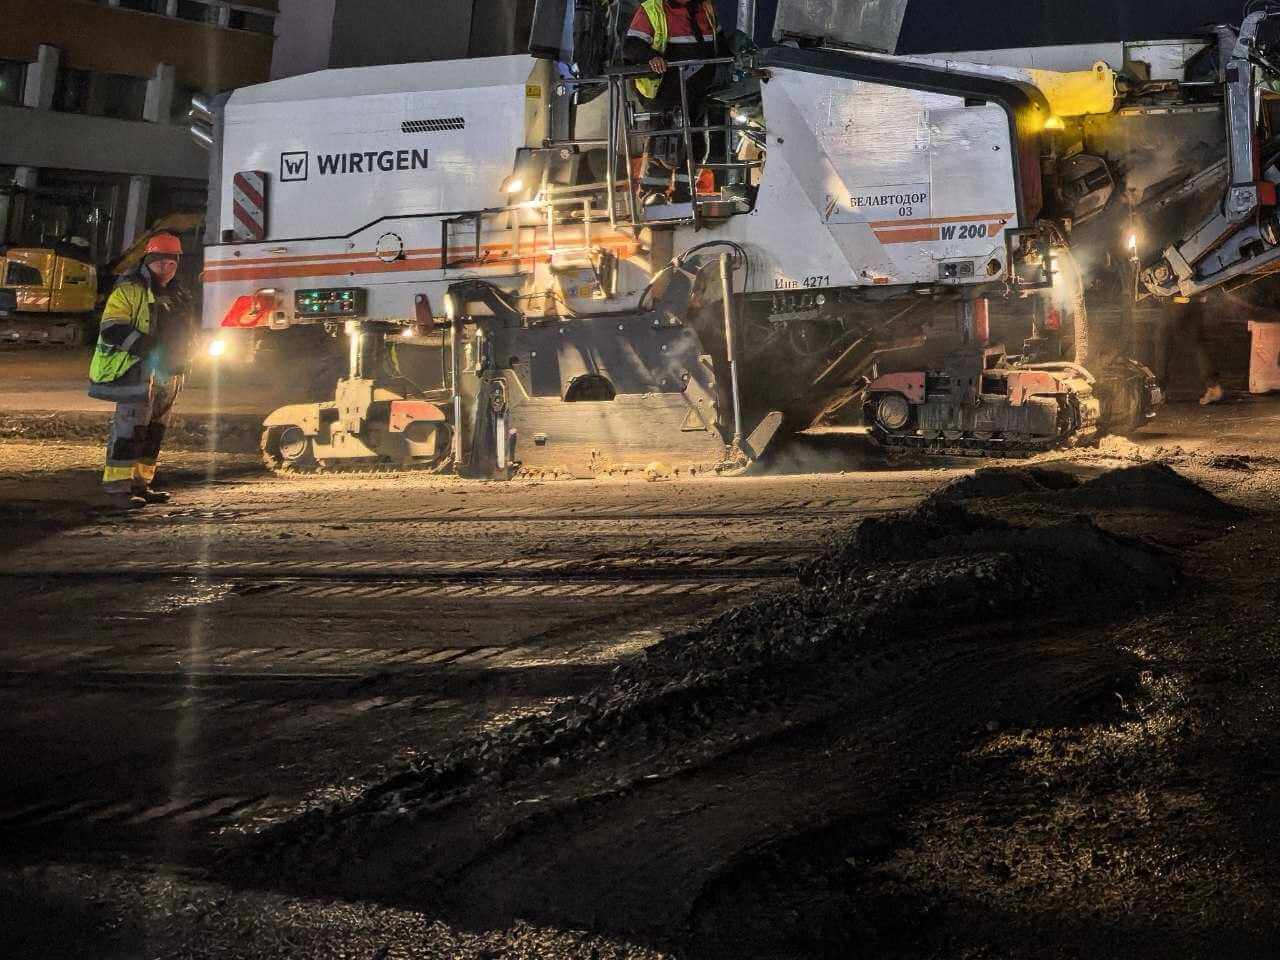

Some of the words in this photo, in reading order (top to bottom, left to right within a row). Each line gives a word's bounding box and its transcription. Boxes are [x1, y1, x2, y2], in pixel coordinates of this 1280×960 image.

[317, 148, 429, 175] WIRTGEN
[850, 192, 927, 208] БЕЛАВТОДОР
[898, 206, 913, 217] 03
[941, 225, 957, 241] W
[958, 223, 987, 240] 200
[803, 275, 830, 288] 4271
